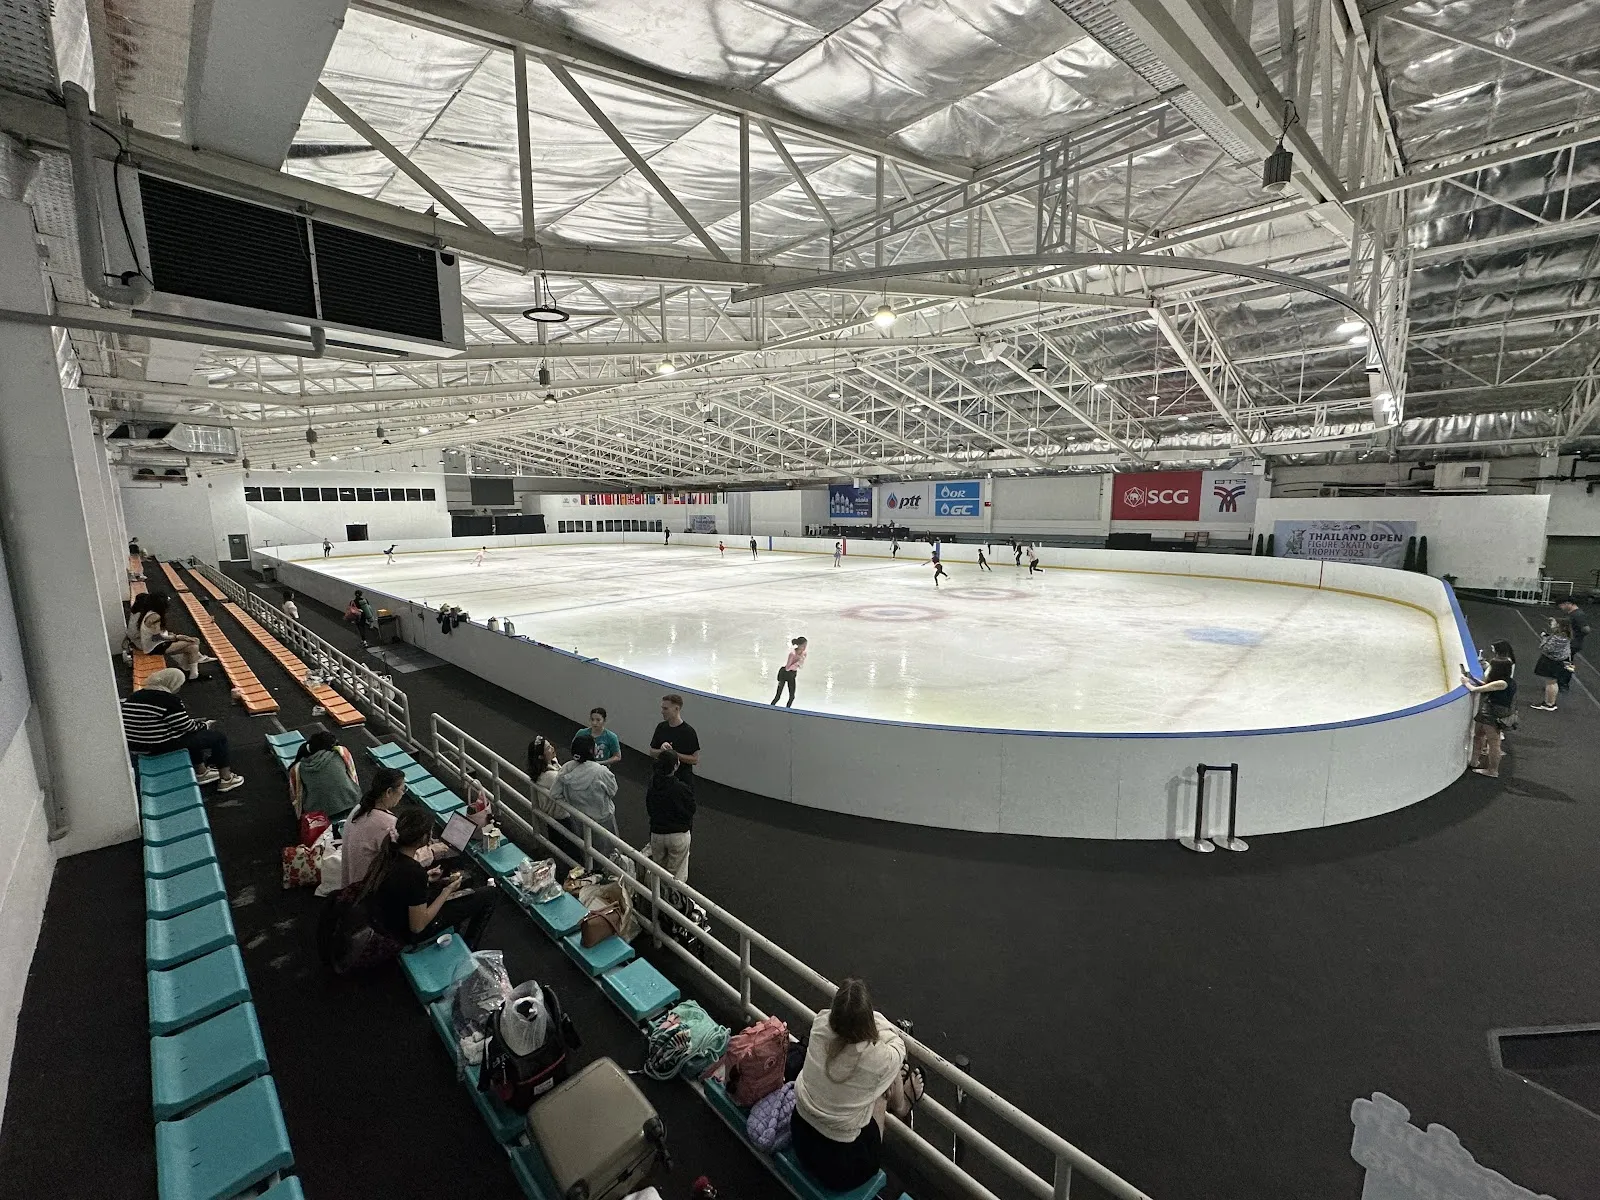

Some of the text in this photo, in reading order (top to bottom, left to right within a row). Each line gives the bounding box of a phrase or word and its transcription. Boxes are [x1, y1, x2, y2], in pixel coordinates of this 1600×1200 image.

[950, 490, 966, 498] OR
[1147, 490, 1188, 504] SCG
[899, 495, 921, 509] ptt
[951, 505, 973, 515] GC
[1309, 533, 1403, 542] THAILAND OPEN
[1308, 541, 1380, 550] FIGURE SKATING
[1307, 548, 1364, 557] TROPHY 2025
